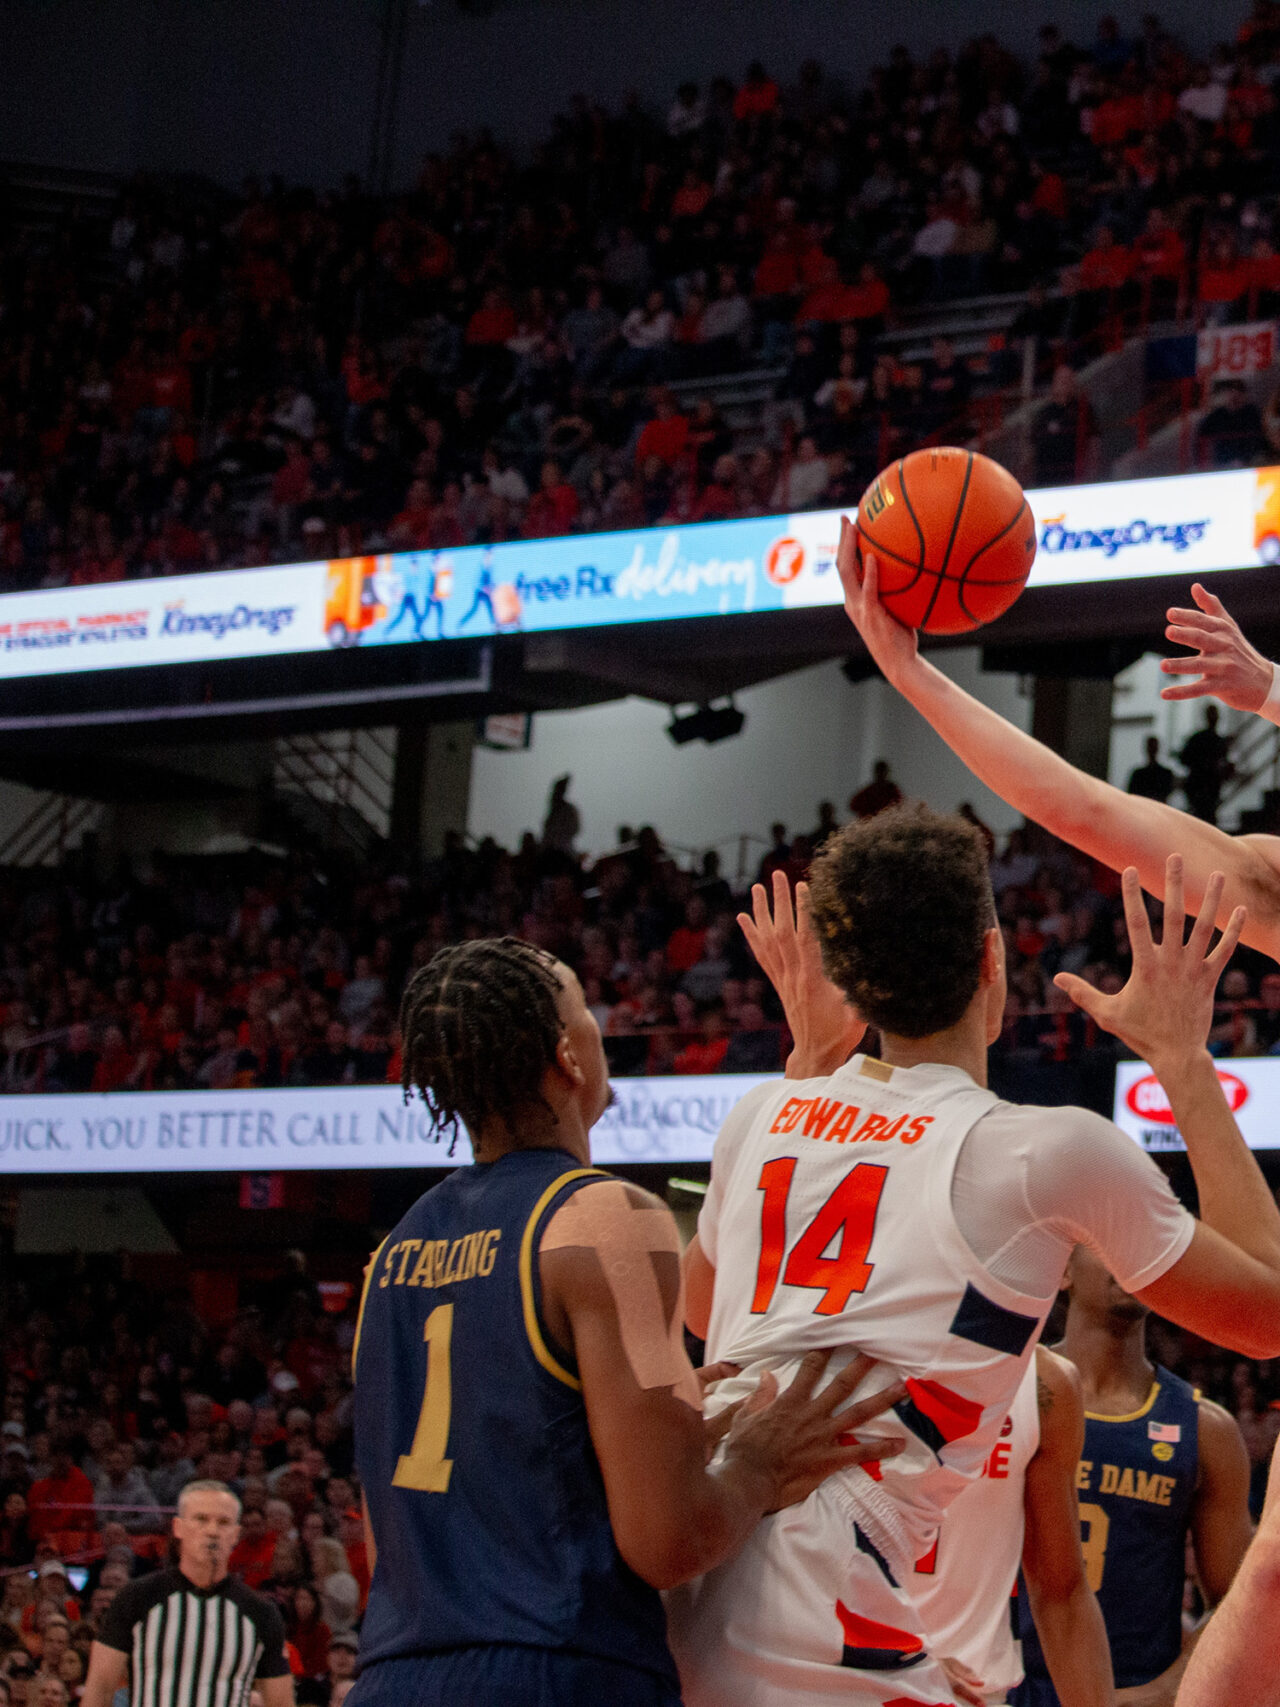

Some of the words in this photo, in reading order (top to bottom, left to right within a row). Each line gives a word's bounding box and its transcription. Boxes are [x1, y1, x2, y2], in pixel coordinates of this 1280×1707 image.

[516, 567, 571, 600] free
[576, 564, 615, 600] Rx
[82, 1116, 146, 1150] YOU
[157, 1109, 279, 1149] BETTER
[287, 1110, 364, 1147] CALL
[769, 1096, 936, 1145] EDWARDS
[379, 1229, 502, 1289] STARLING
[750, 1156, 890, 1316] 14
[391, 1303, 454, 1494] 1
[1099, 1463, 1177, 1507] DAME
